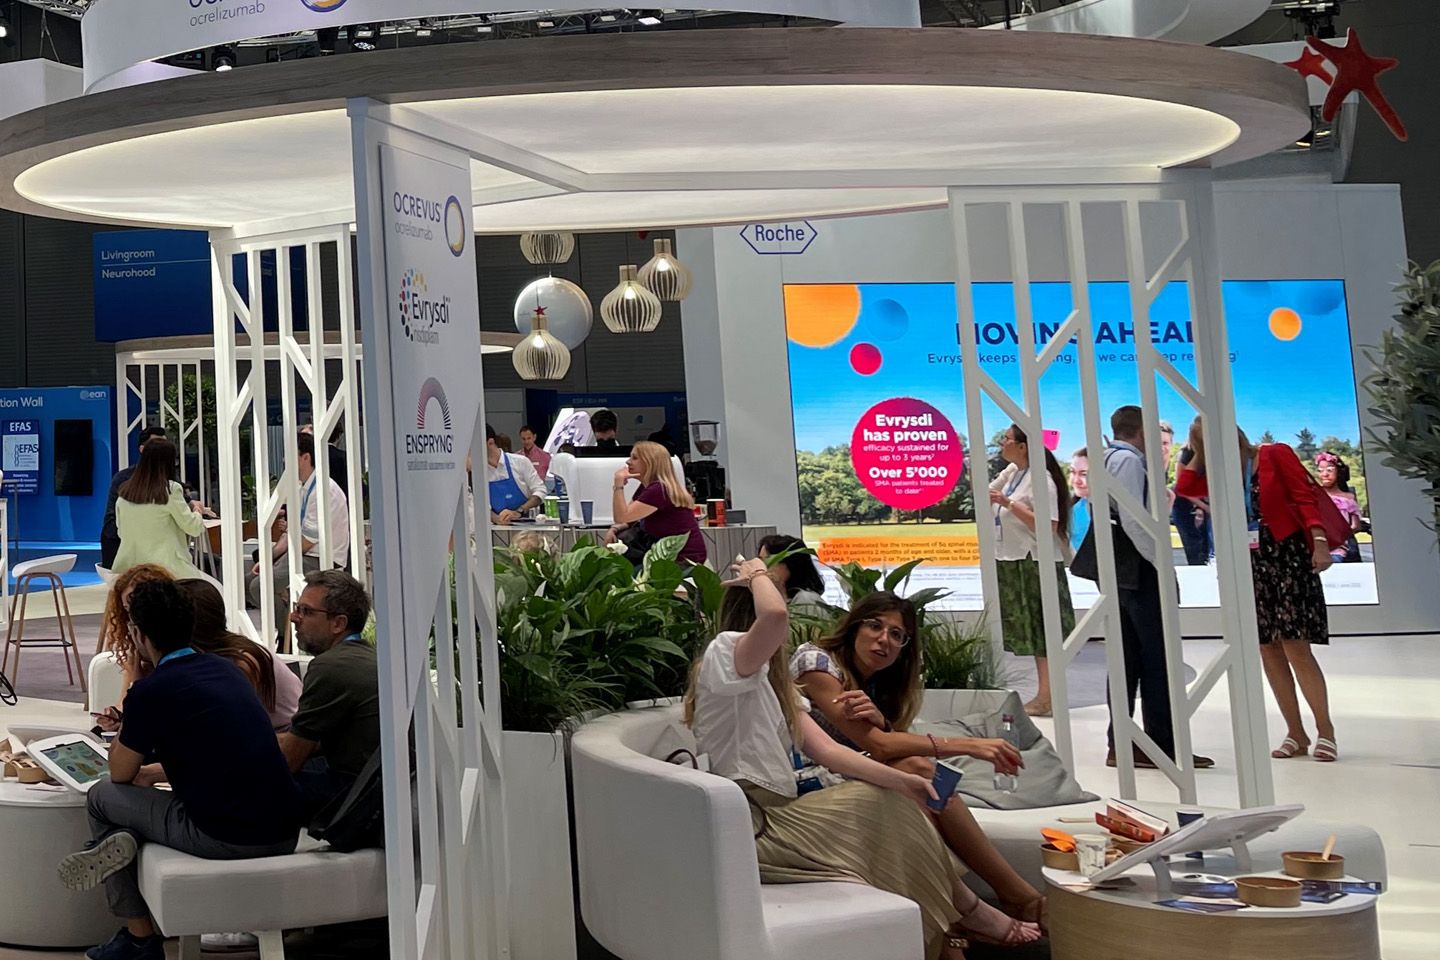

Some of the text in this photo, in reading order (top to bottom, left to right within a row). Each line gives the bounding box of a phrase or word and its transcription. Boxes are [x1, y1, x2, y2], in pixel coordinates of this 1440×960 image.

[190, 1, 266, 27] ocrelizumab
[755, 224, 805, 241] Roche
[101, 249, 155, 262] Livingroom
[102, 266, 157, 279] Neurohood
[412, 292, 449, 328] Evrysdi
[1095, 321, 1194, 344] AHEA
[928, 353, 962, 365] Evrys
[979, 352, 1016, 364] keeps
[1120, 354, 1138, 362] ca
[89, 390, 107, 398] ean
[20, 396, 44, 407] Wall
[9, 422, 32, 432] EFAS
[875, 413, 933, 428] Evrysdi
[863, 429, 947, 443] has proven
[19, 443, 39, 453] EFAS
[863, 444, 895, 452] efficacy
[879, 454, 890, 462] up
[869, 466, 948, 478] Over 5'000
